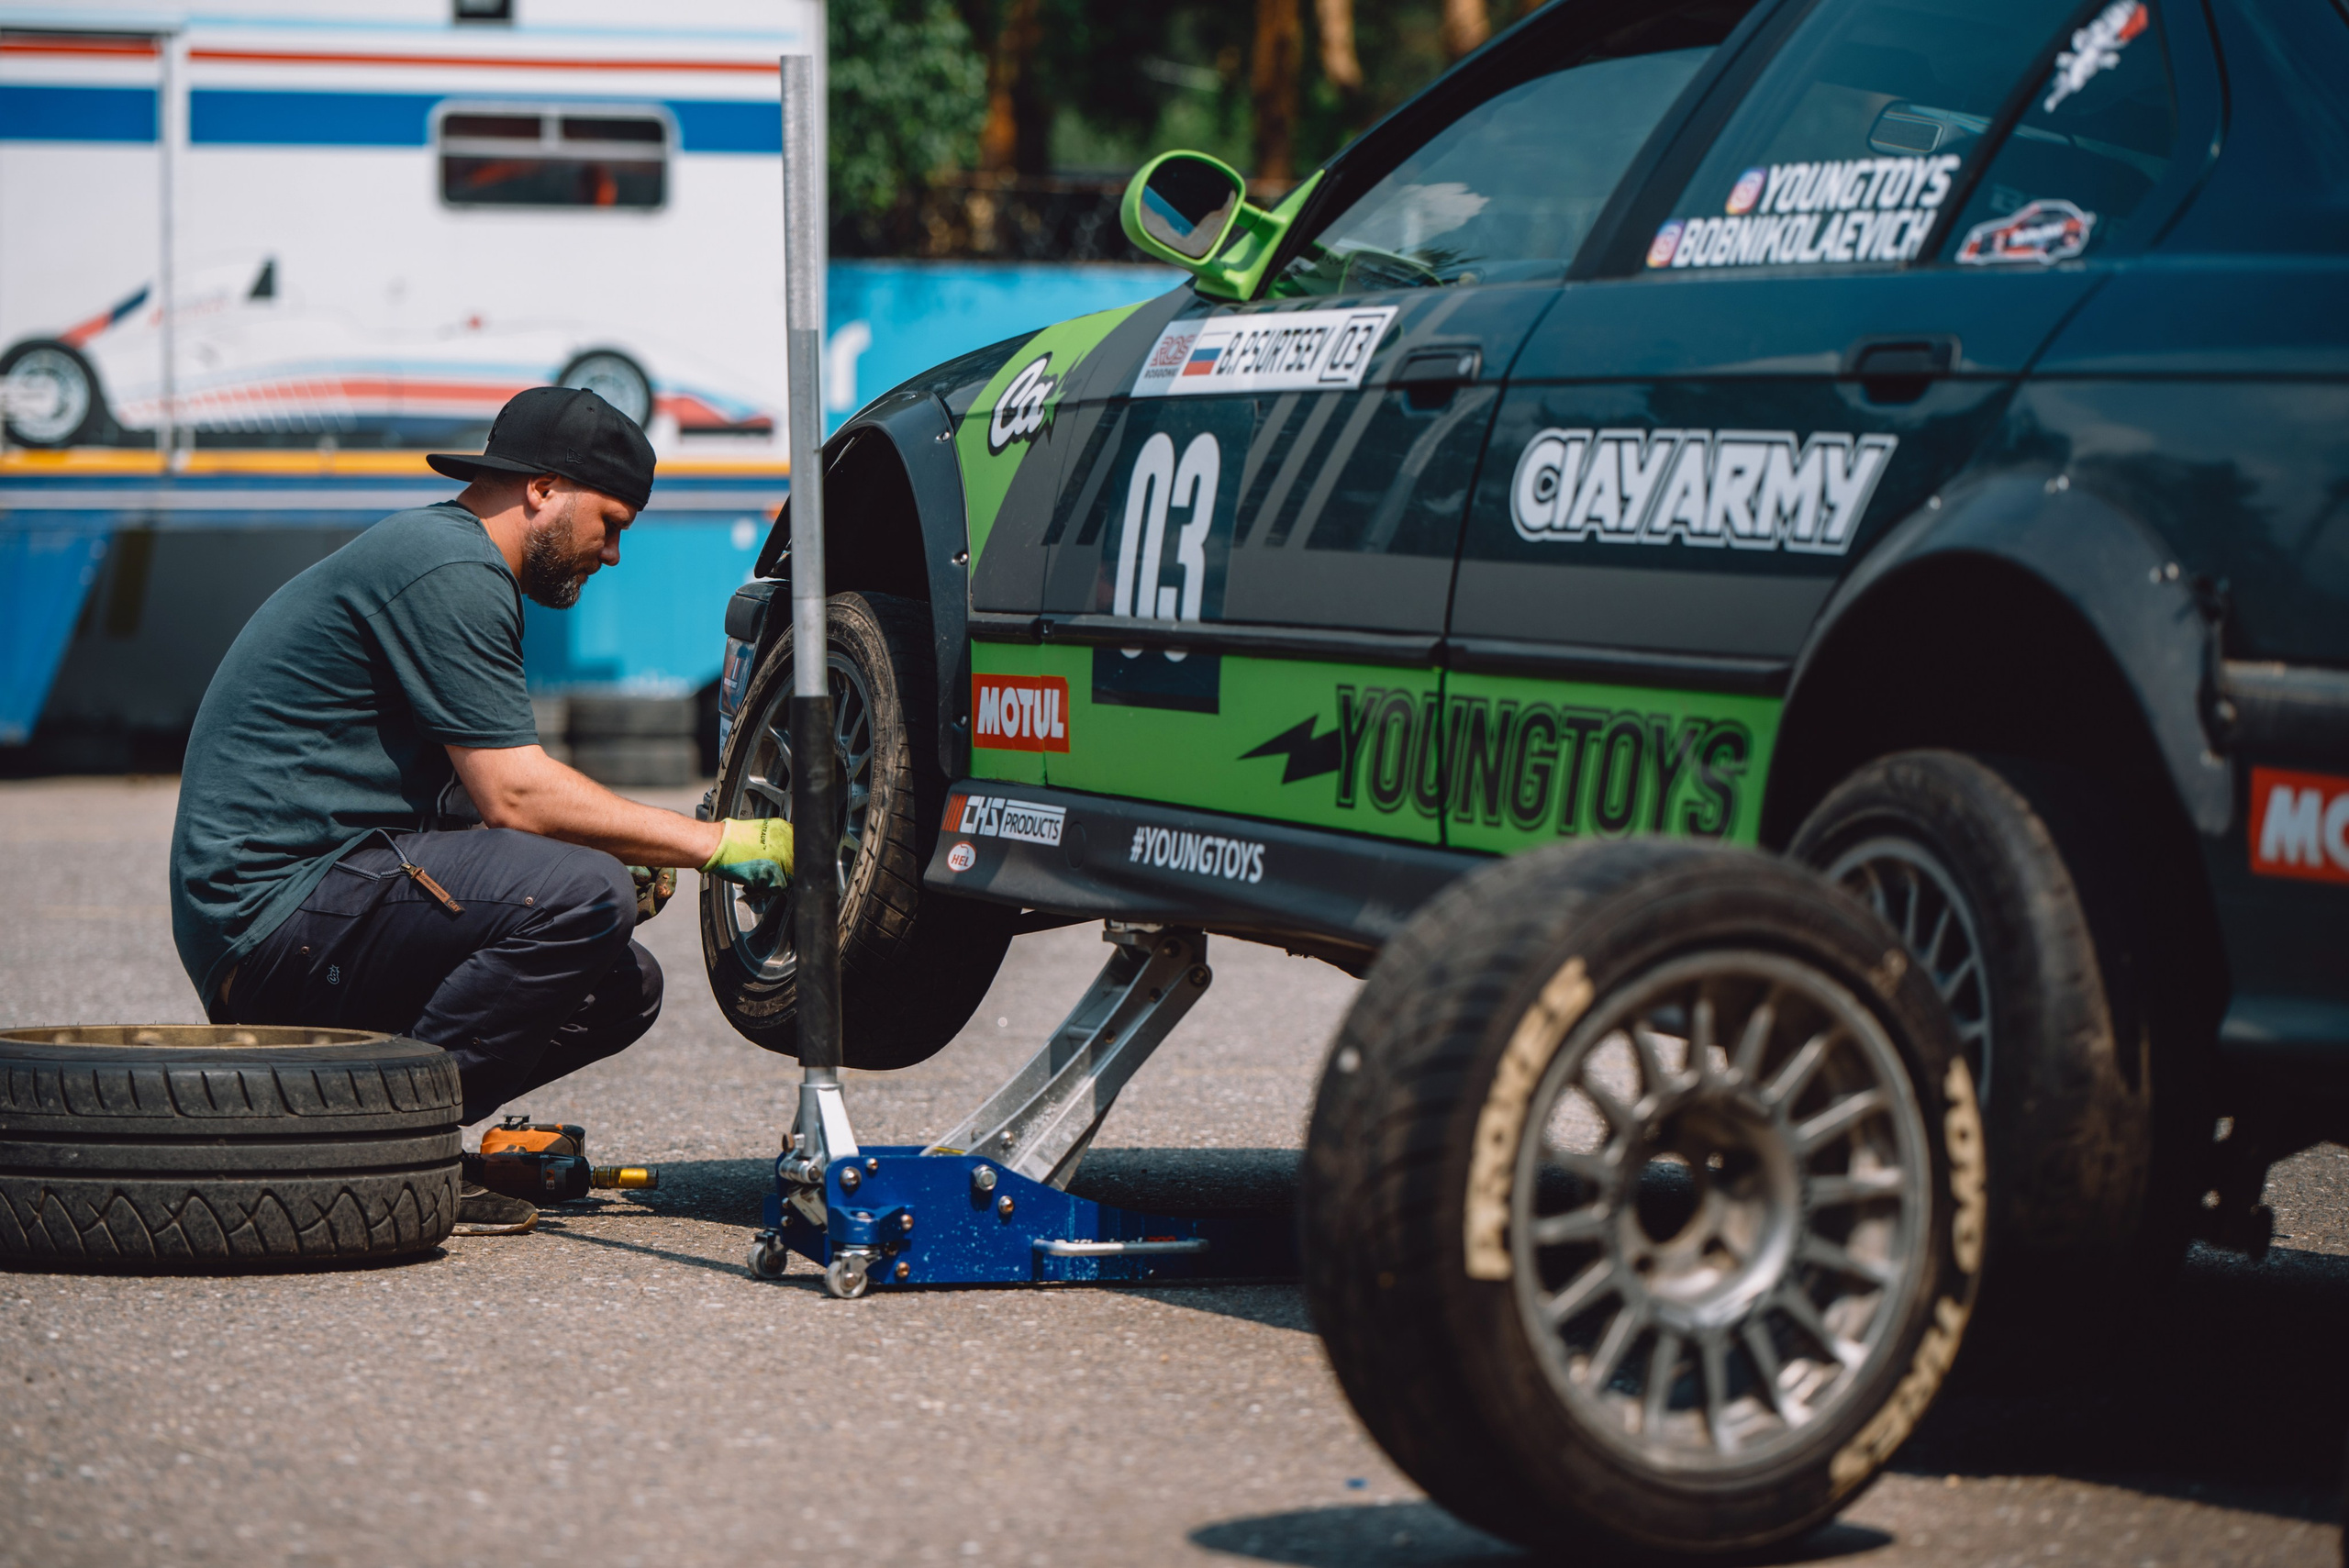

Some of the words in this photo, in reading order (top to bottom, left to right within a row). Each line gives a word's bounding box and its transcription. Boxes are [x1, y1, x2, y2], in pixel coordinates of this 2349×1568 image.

[1759, 153, 1961, 215] YOUNGTOYS
[1672, 208, 1937, 268] BOBNIKOLAEVICH
[1329, 324, 1375, 373] 03
[1113, 431, 1220, 659] 03
[977, 686, 1064, 740] MOTUL
[1336, 684, 1753, 842] YOUNGTOYS
[1003, 812, 1061, 840] PRODUCTS
[1129, 826, 1266, 884] #YOUNGTOYS
[951, 853, 971, 867] HEL
